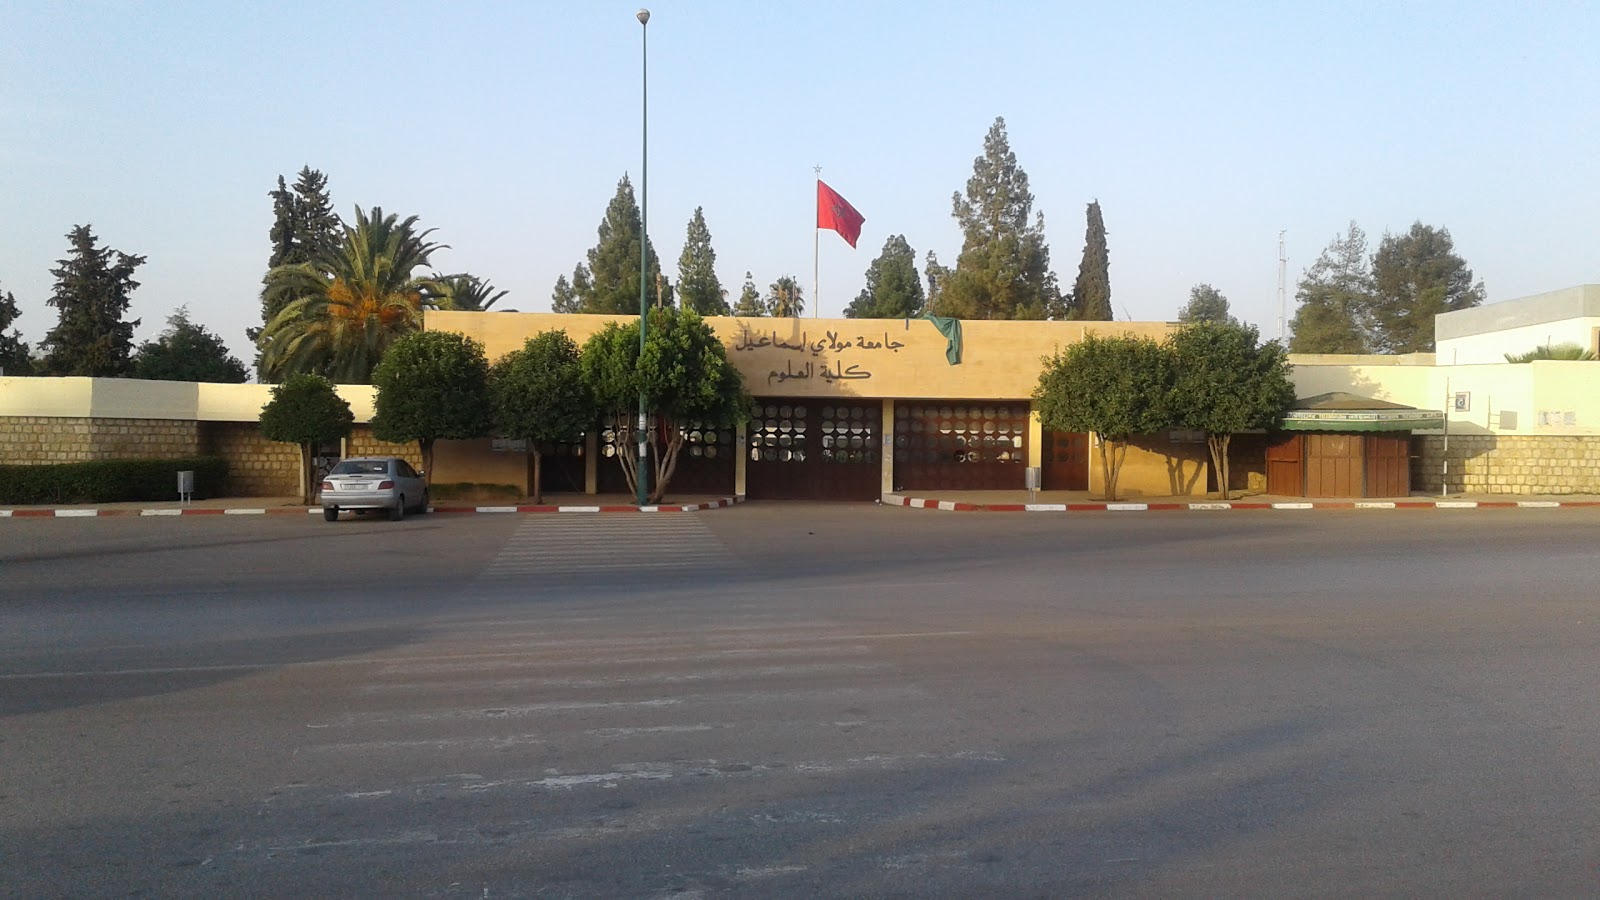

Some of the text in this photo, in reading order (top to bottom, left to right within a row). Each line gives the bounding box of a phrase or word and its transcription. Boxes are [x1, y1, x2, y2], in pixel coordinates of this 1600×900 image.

[736, 330, 905, 357] جامعة مولاي إسماعيل
[768, 360, 872, 386] كلية العلوم
